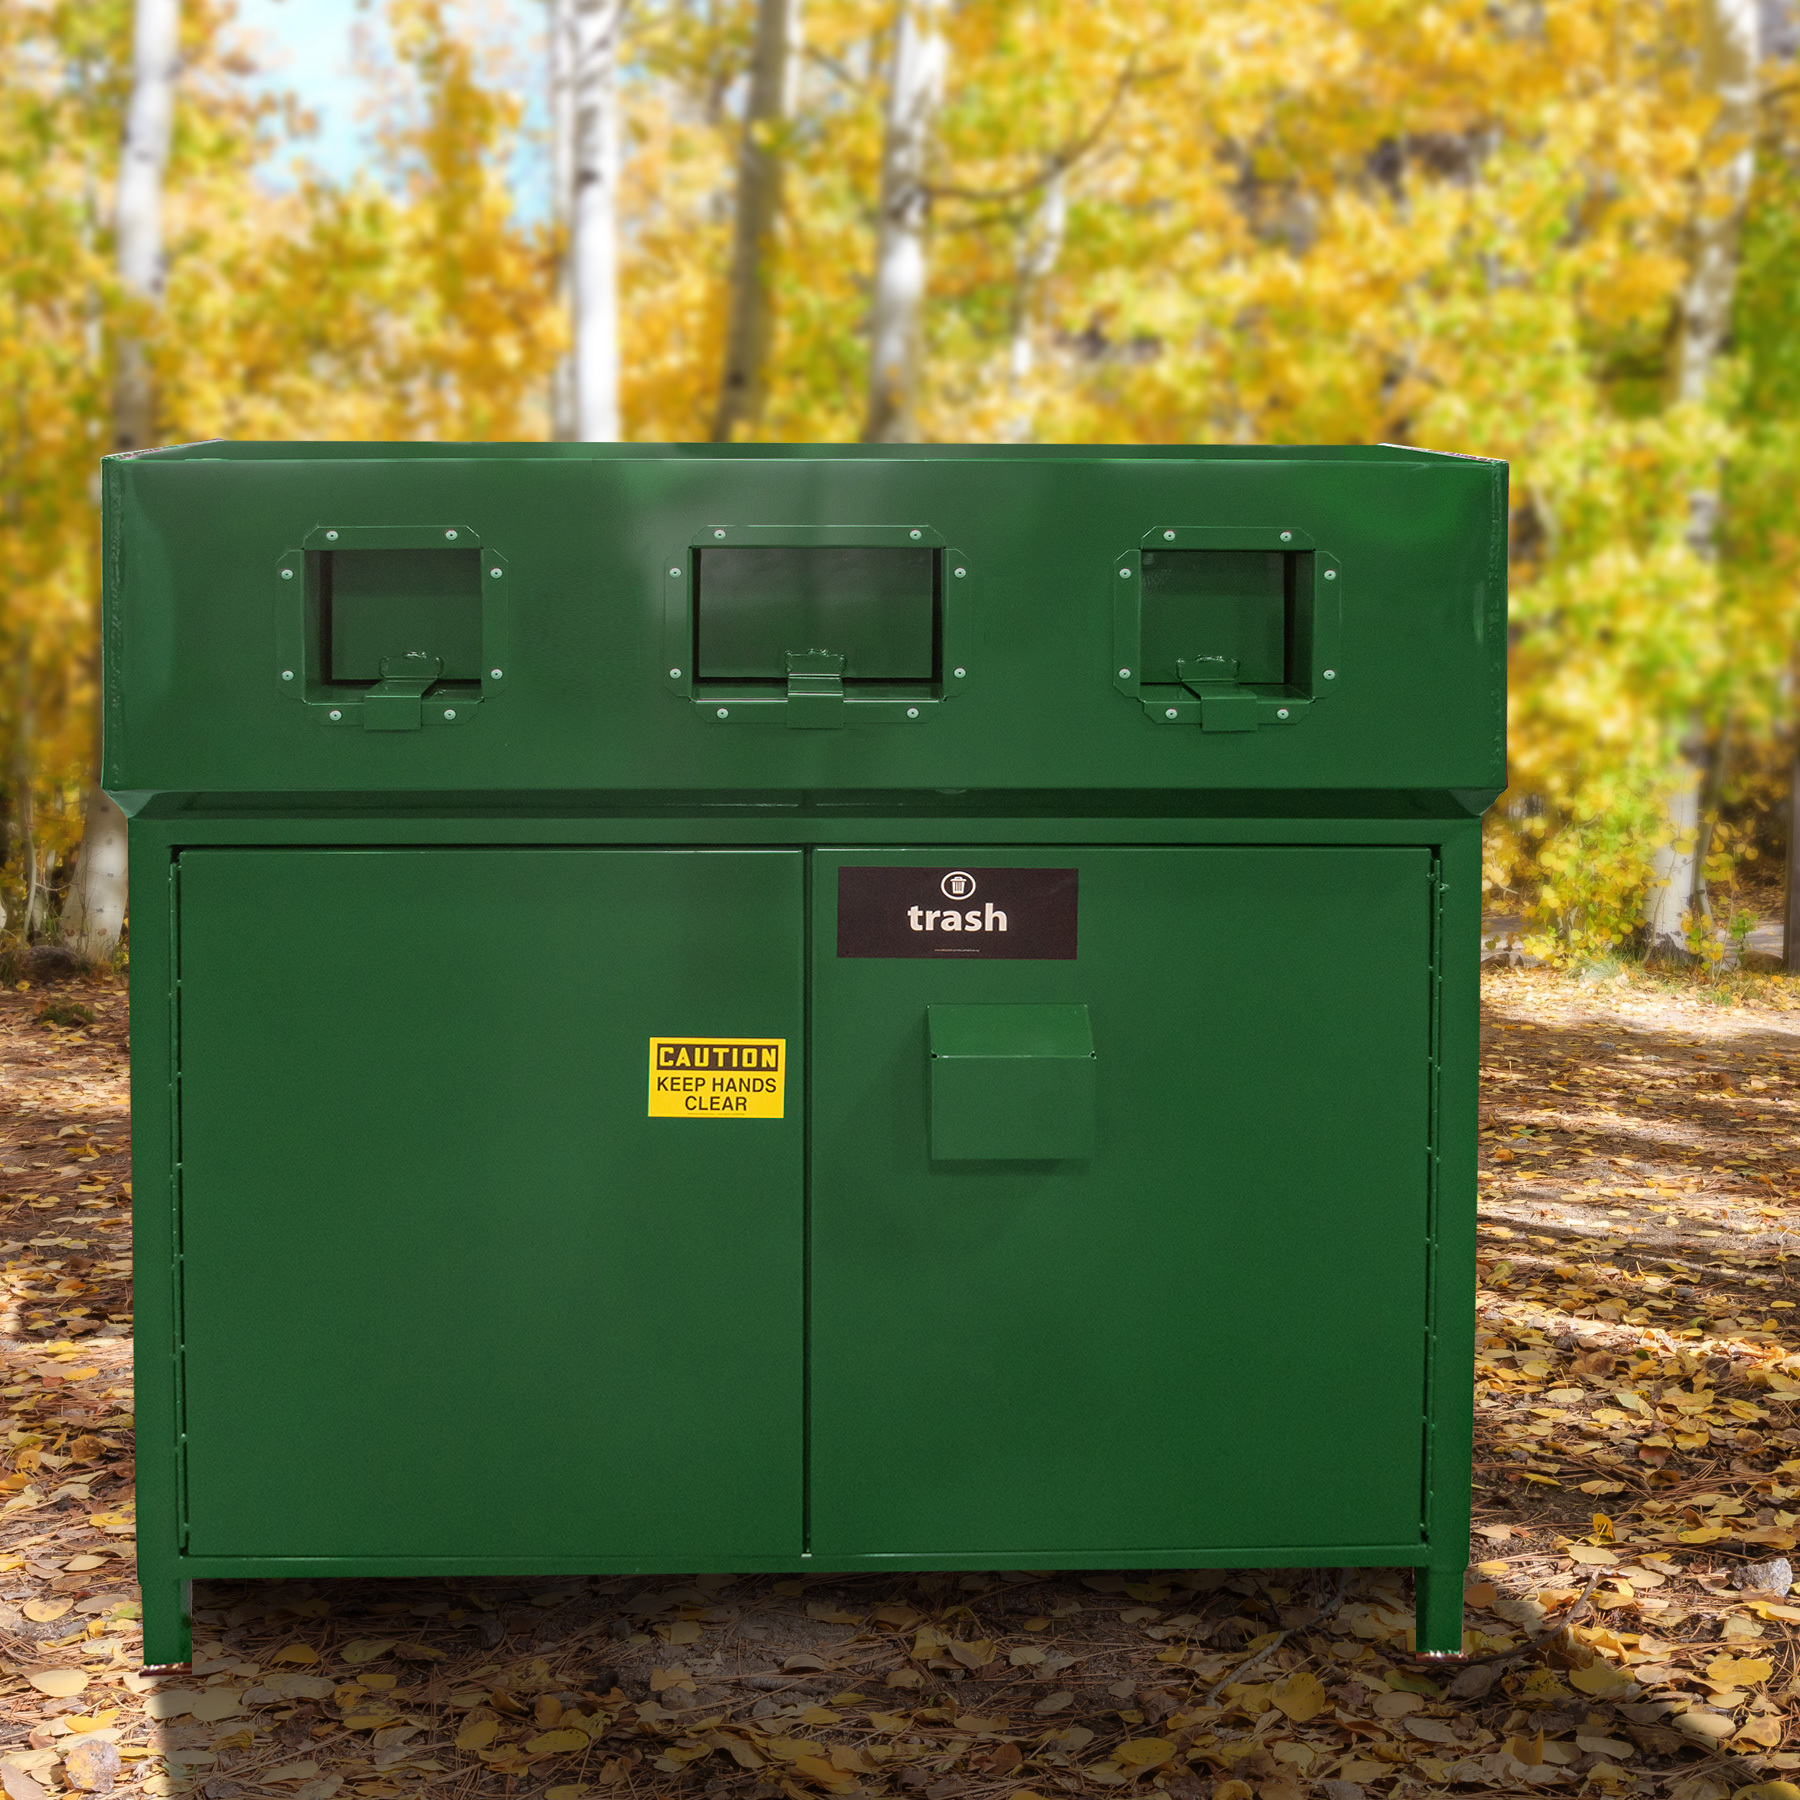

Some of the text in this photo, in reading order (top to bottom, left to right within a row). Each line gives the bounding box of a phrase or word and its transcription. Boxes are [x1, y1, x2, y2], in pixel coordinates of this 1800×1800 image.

[907, 902, 1008, 932] trash
[659, 1047, 777, 1068] CAUTION
[657, 1076, 777, 1093] KEEP HANDS
[685, 1095, 747, 1111] CLEAR
